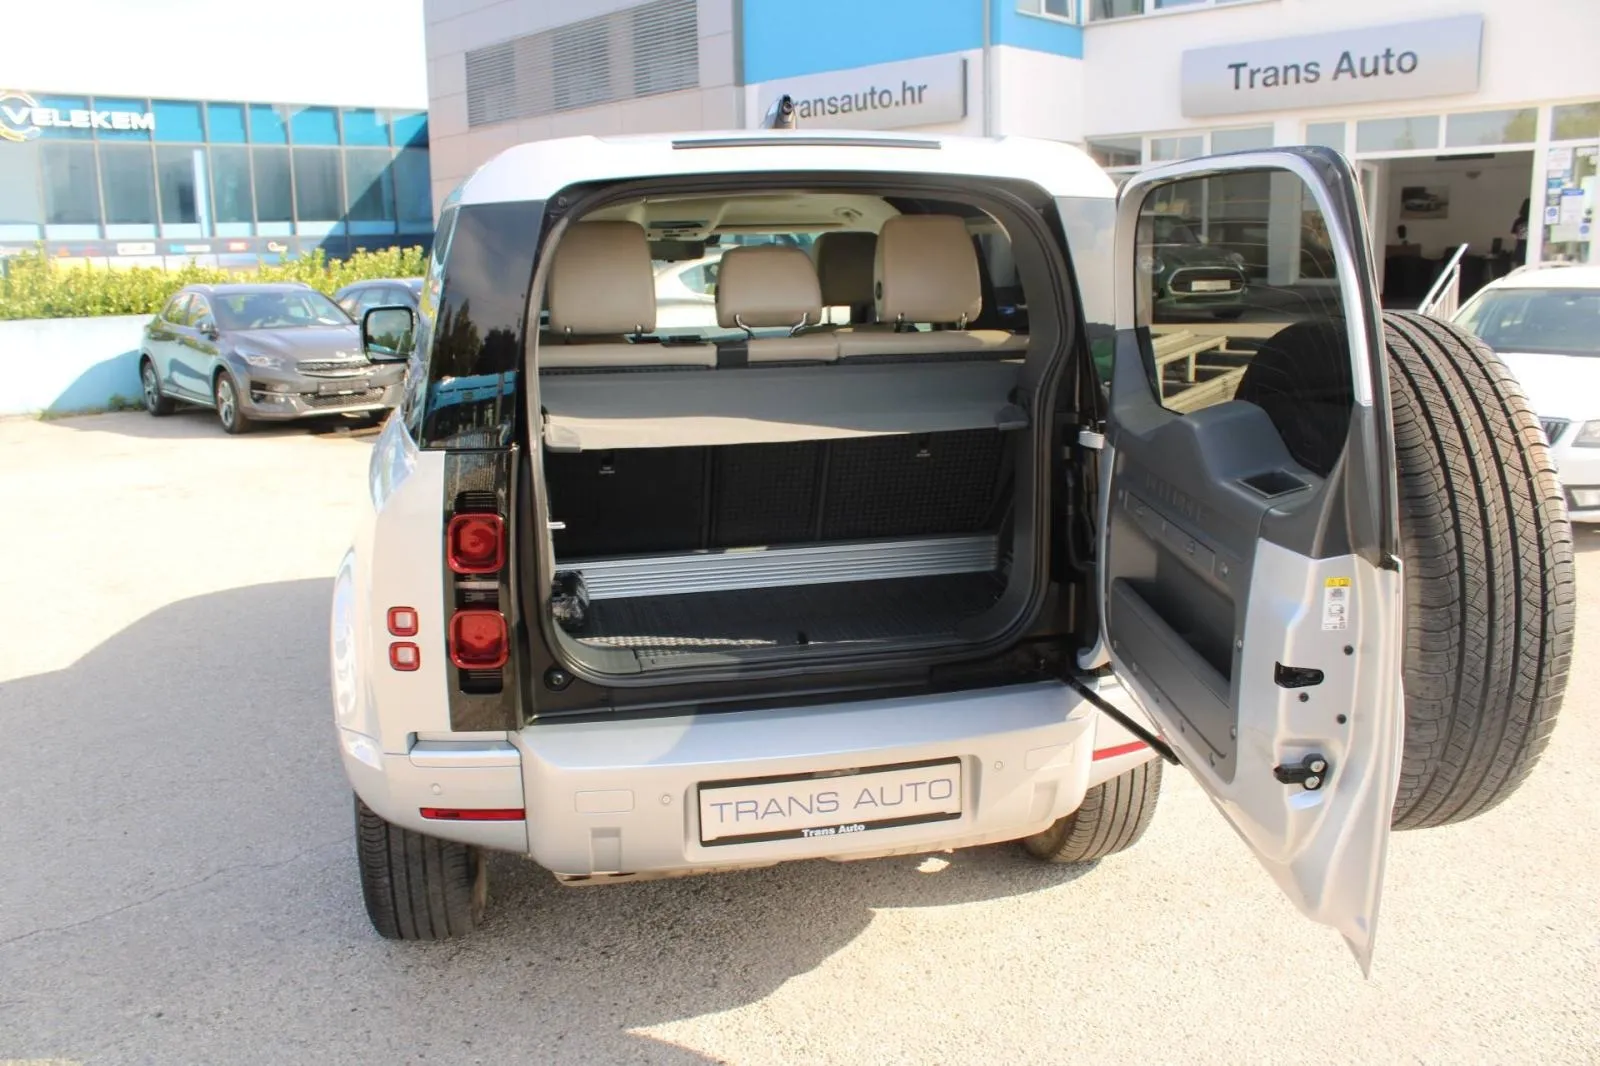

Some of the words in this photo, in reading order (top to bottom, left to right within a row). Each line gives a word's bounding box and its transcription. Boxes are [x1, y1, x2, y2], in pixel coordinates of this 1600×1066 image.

[1228, 60, 1320, 90] Trans
[1332, 48, 1418, 80] Auto
[1, 104, 155, 130] VELEKEM
[791, 81, 927, 119] ansauto.hr
[710, 791, 840, 823] TRANS
[853, 778, 953, 810] AUTO
[801, 827, 836, 838] Trans
[838, 823, 866, 834] Auto
